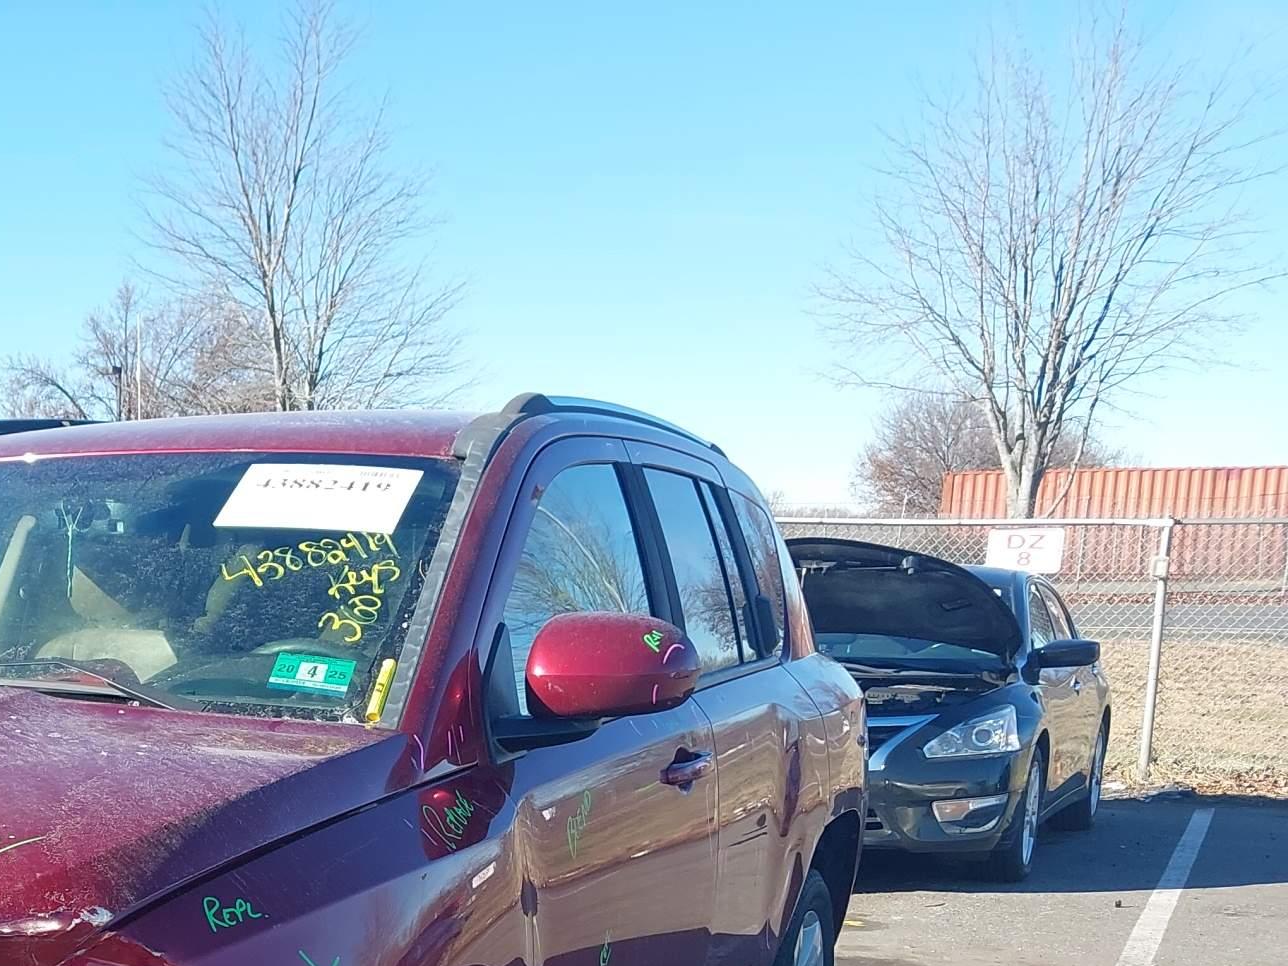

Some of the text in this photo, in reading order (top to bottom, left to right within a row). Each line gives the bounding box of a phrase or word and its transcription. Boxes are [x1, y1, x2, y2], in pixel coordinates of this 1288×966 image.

[1017, 551, 1031, 566] 8
[277, 663, 347, 680] 20 4 25
